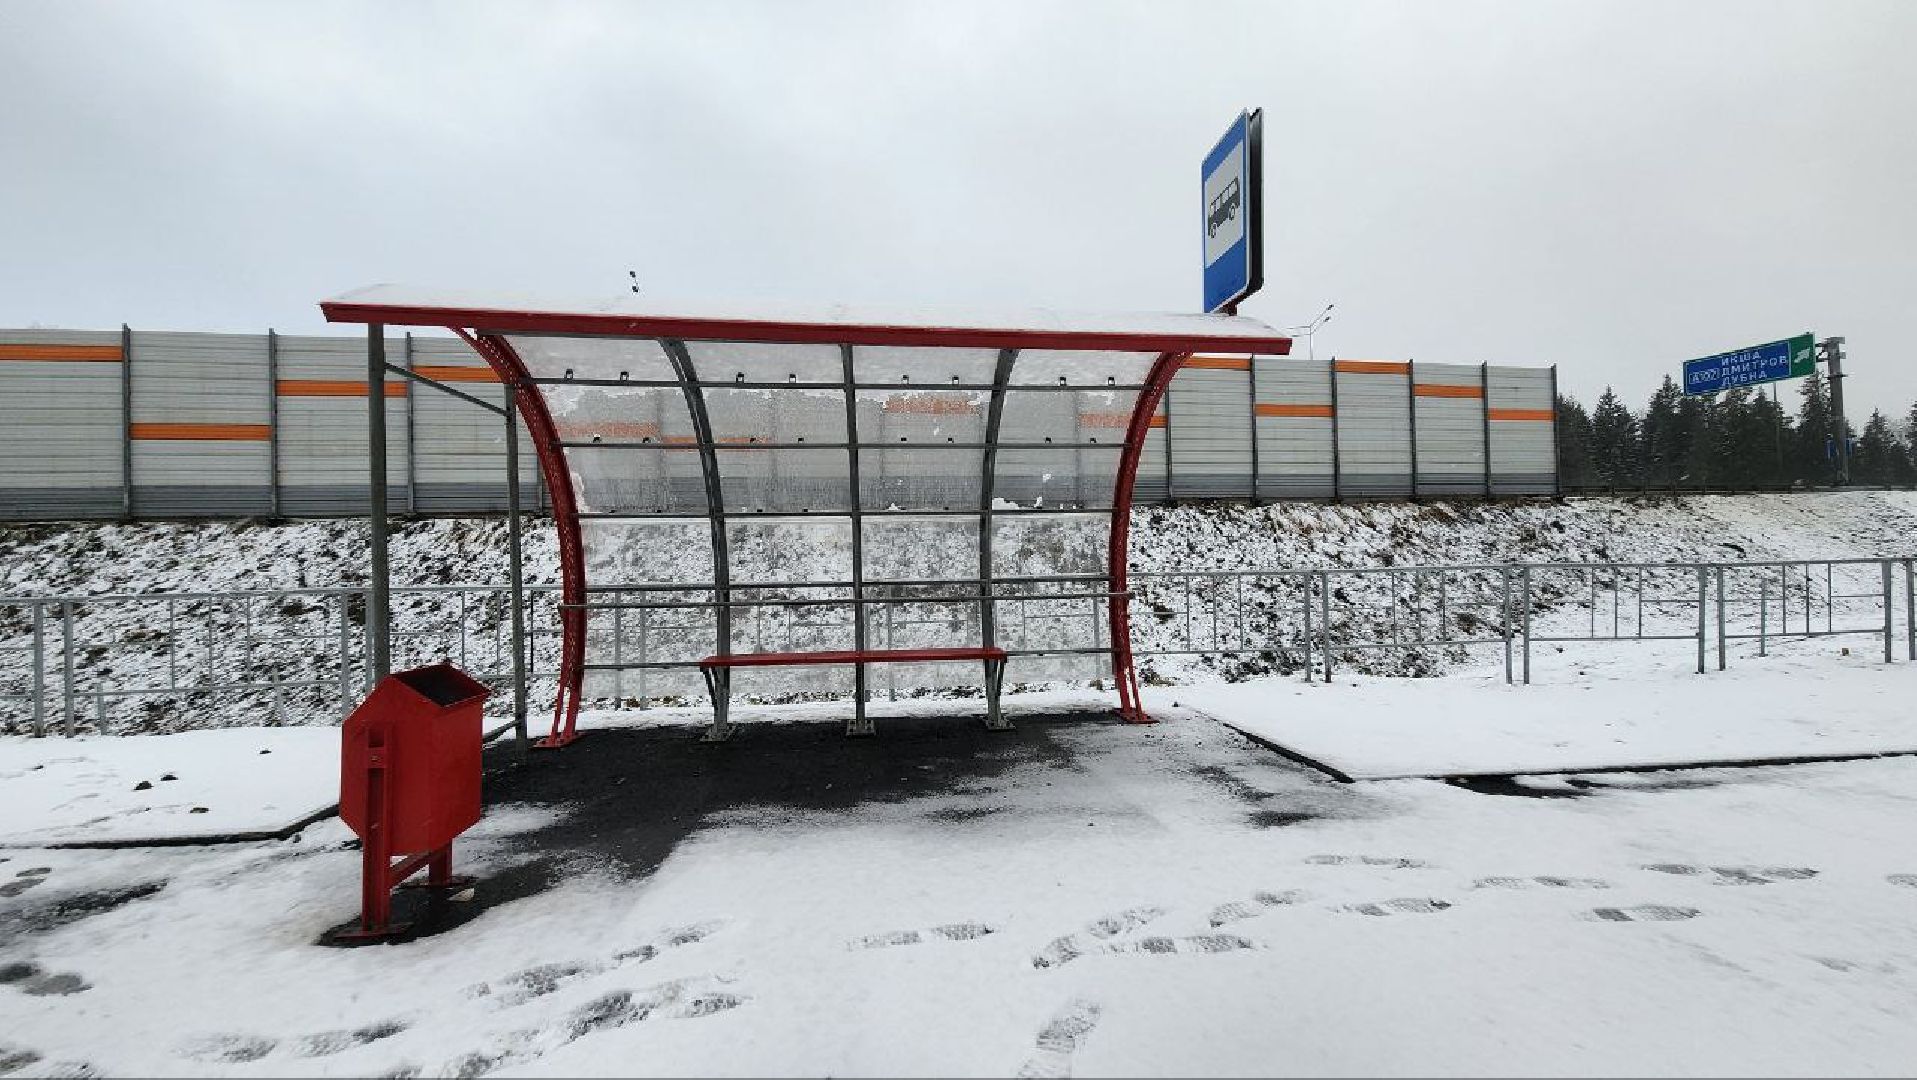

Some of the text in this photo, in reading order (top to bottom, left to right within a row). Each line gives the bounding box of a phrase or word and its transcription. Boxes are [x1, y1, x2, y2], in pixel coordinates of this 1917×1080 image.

[1721, 351, 1761, 366] ИКША
[1722, 356, 1788, 376] ДМИТРОВ
[1721, 371, 1767, 387] ДУБНА
